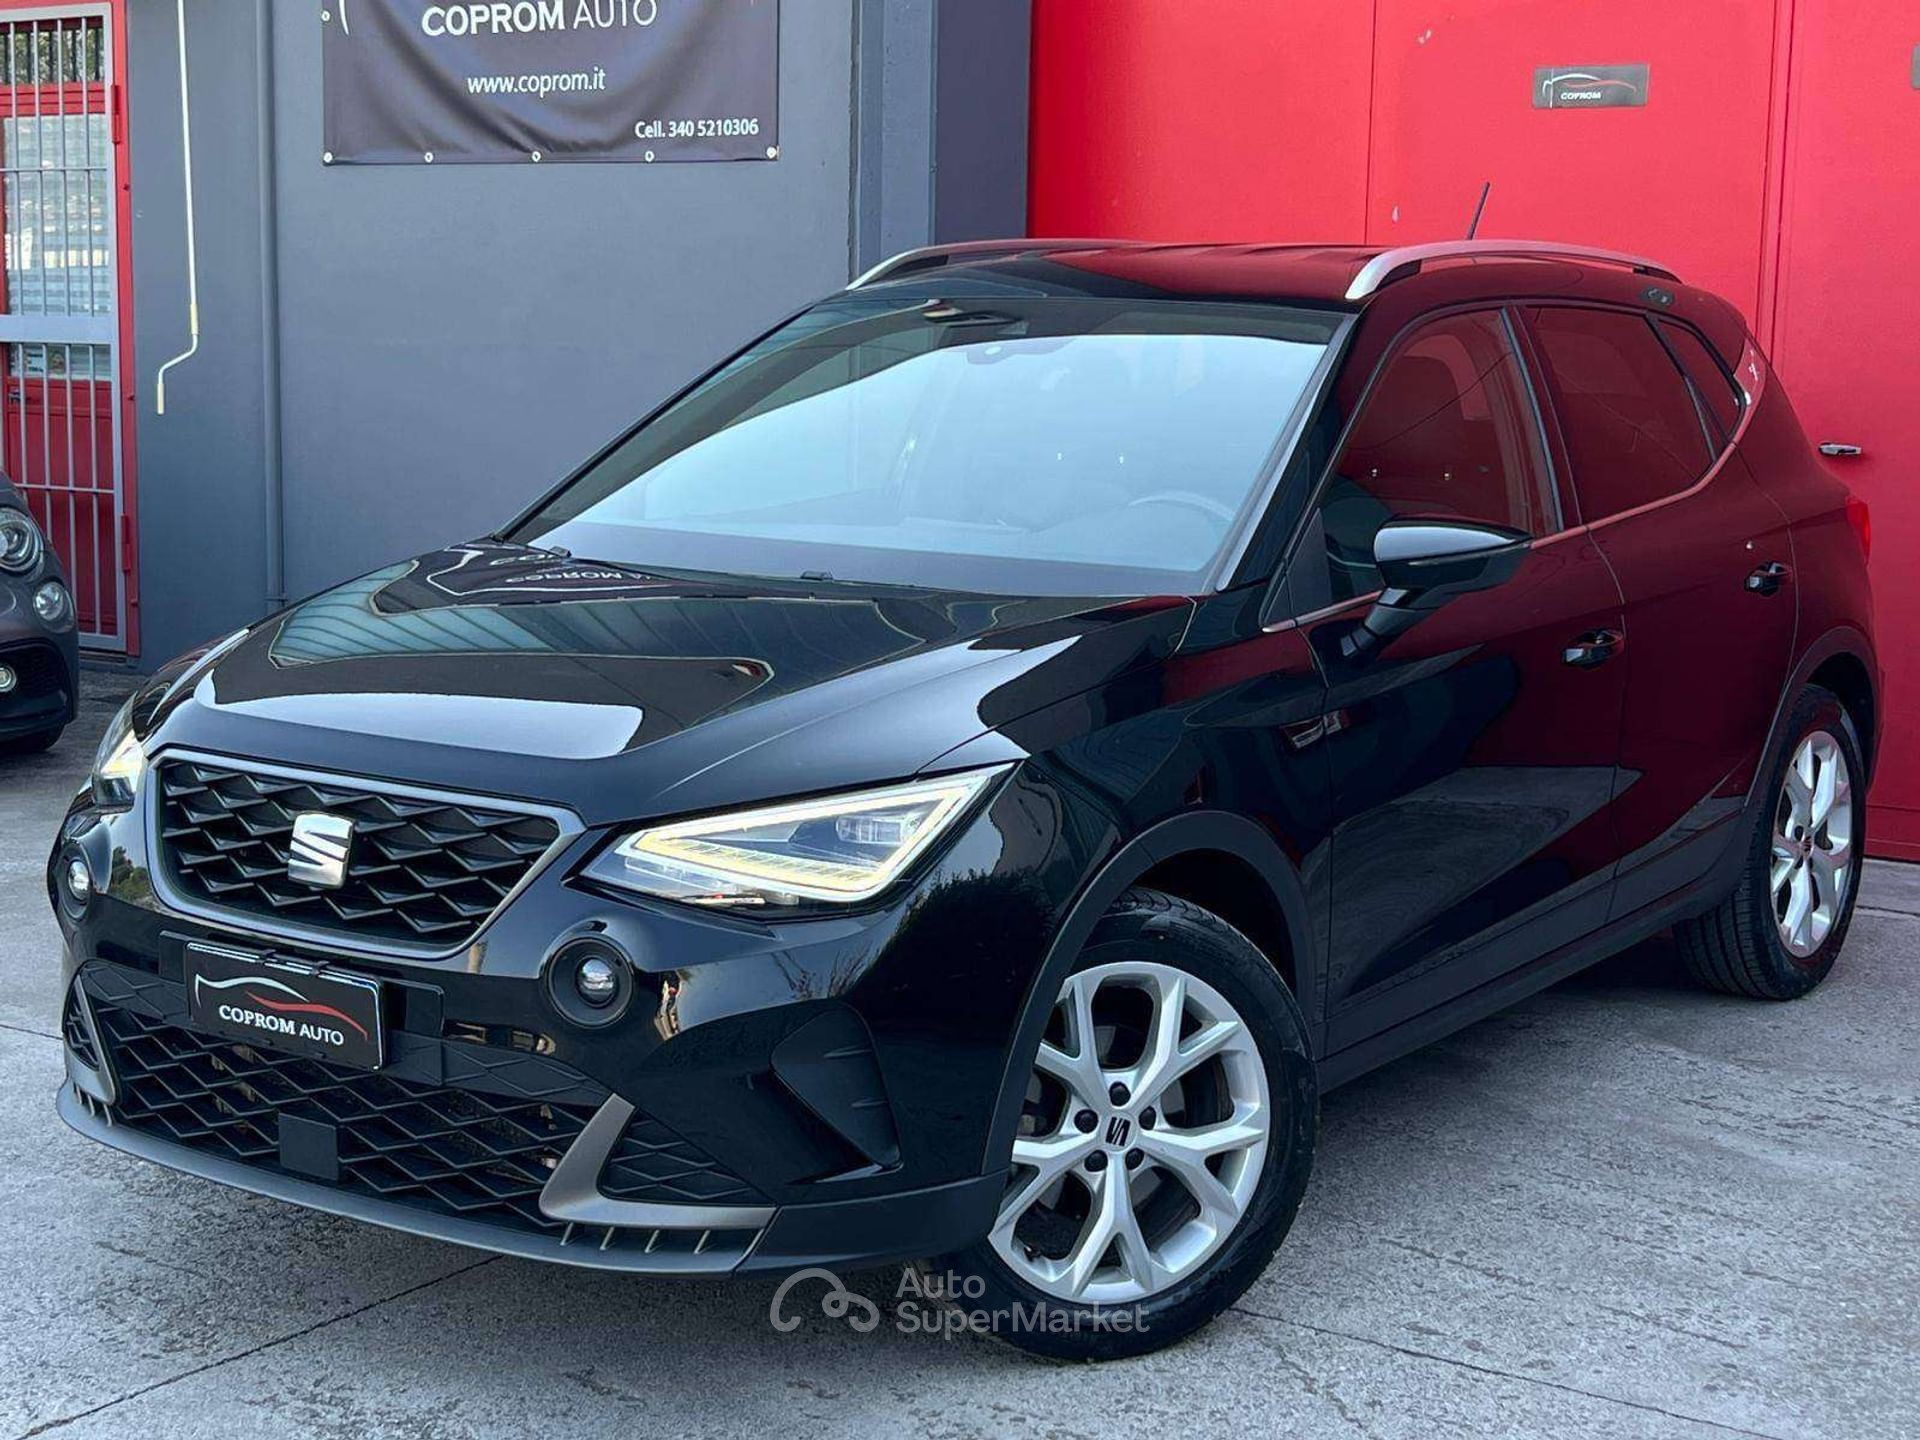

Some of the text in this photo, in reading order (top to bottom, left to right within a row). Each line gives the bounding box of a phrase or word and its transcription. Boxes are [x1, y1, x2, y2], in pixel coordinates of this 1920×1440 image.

[421, 0, 658, 36] COPROM AUTO
[467, 67, 606, 98] www.coprom.it
[635, 118, 760, 138] Cell. 340 5210306
[218, 1004, 345, 1046] COPROM AUTO
